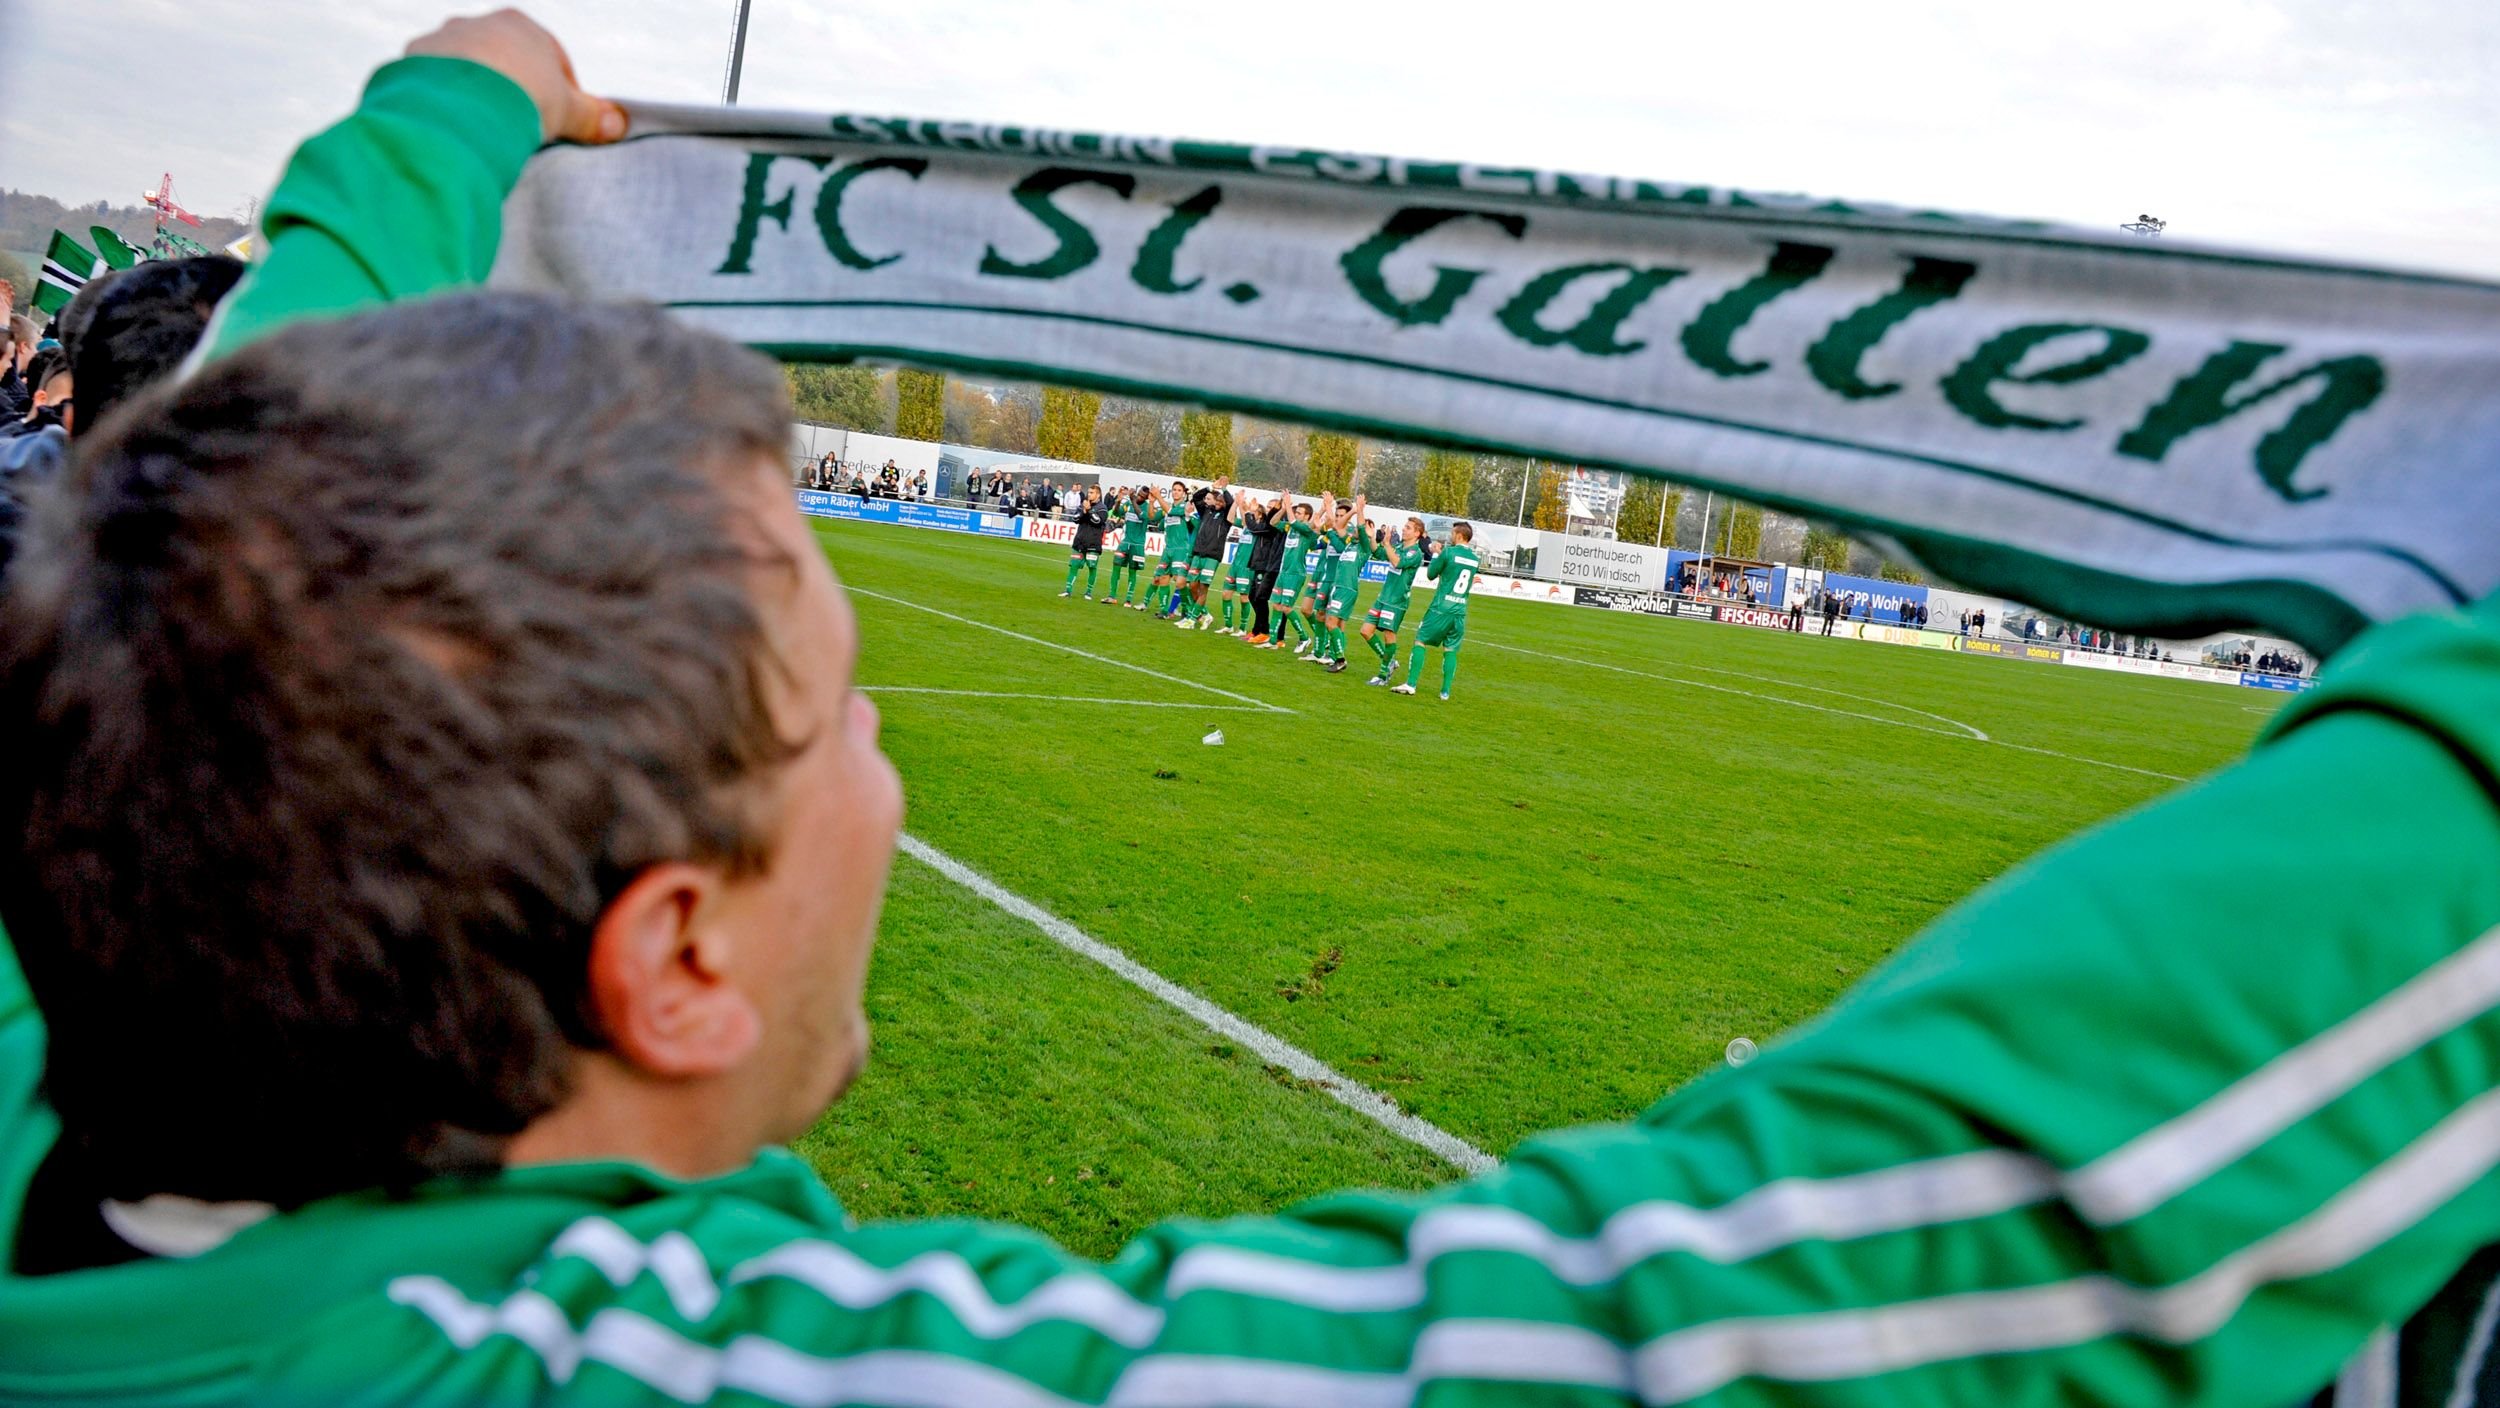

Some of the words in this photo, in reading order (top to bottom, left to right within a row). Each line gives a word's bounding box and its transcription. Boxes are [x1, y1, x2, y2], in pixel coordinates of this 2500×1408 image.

[711, 152, 929, 274] FC
[978, 167, 1262, 304] St.
[1338, 205, 2389, 504] Gallen
[798, 492, 828, 505] Eugen
[831, 496, 858, 508] Räber
[860, 501, 890, 512] GmbH
[1565, 543, 1643, 565] roberthuber.ch
[1453, 569, 1471, 594] 8
[1562, 562, 1590, 576] 5210
[1592, 565, 1641, 583] Windisch
[1883, 628, 1920, 645] DUSS
